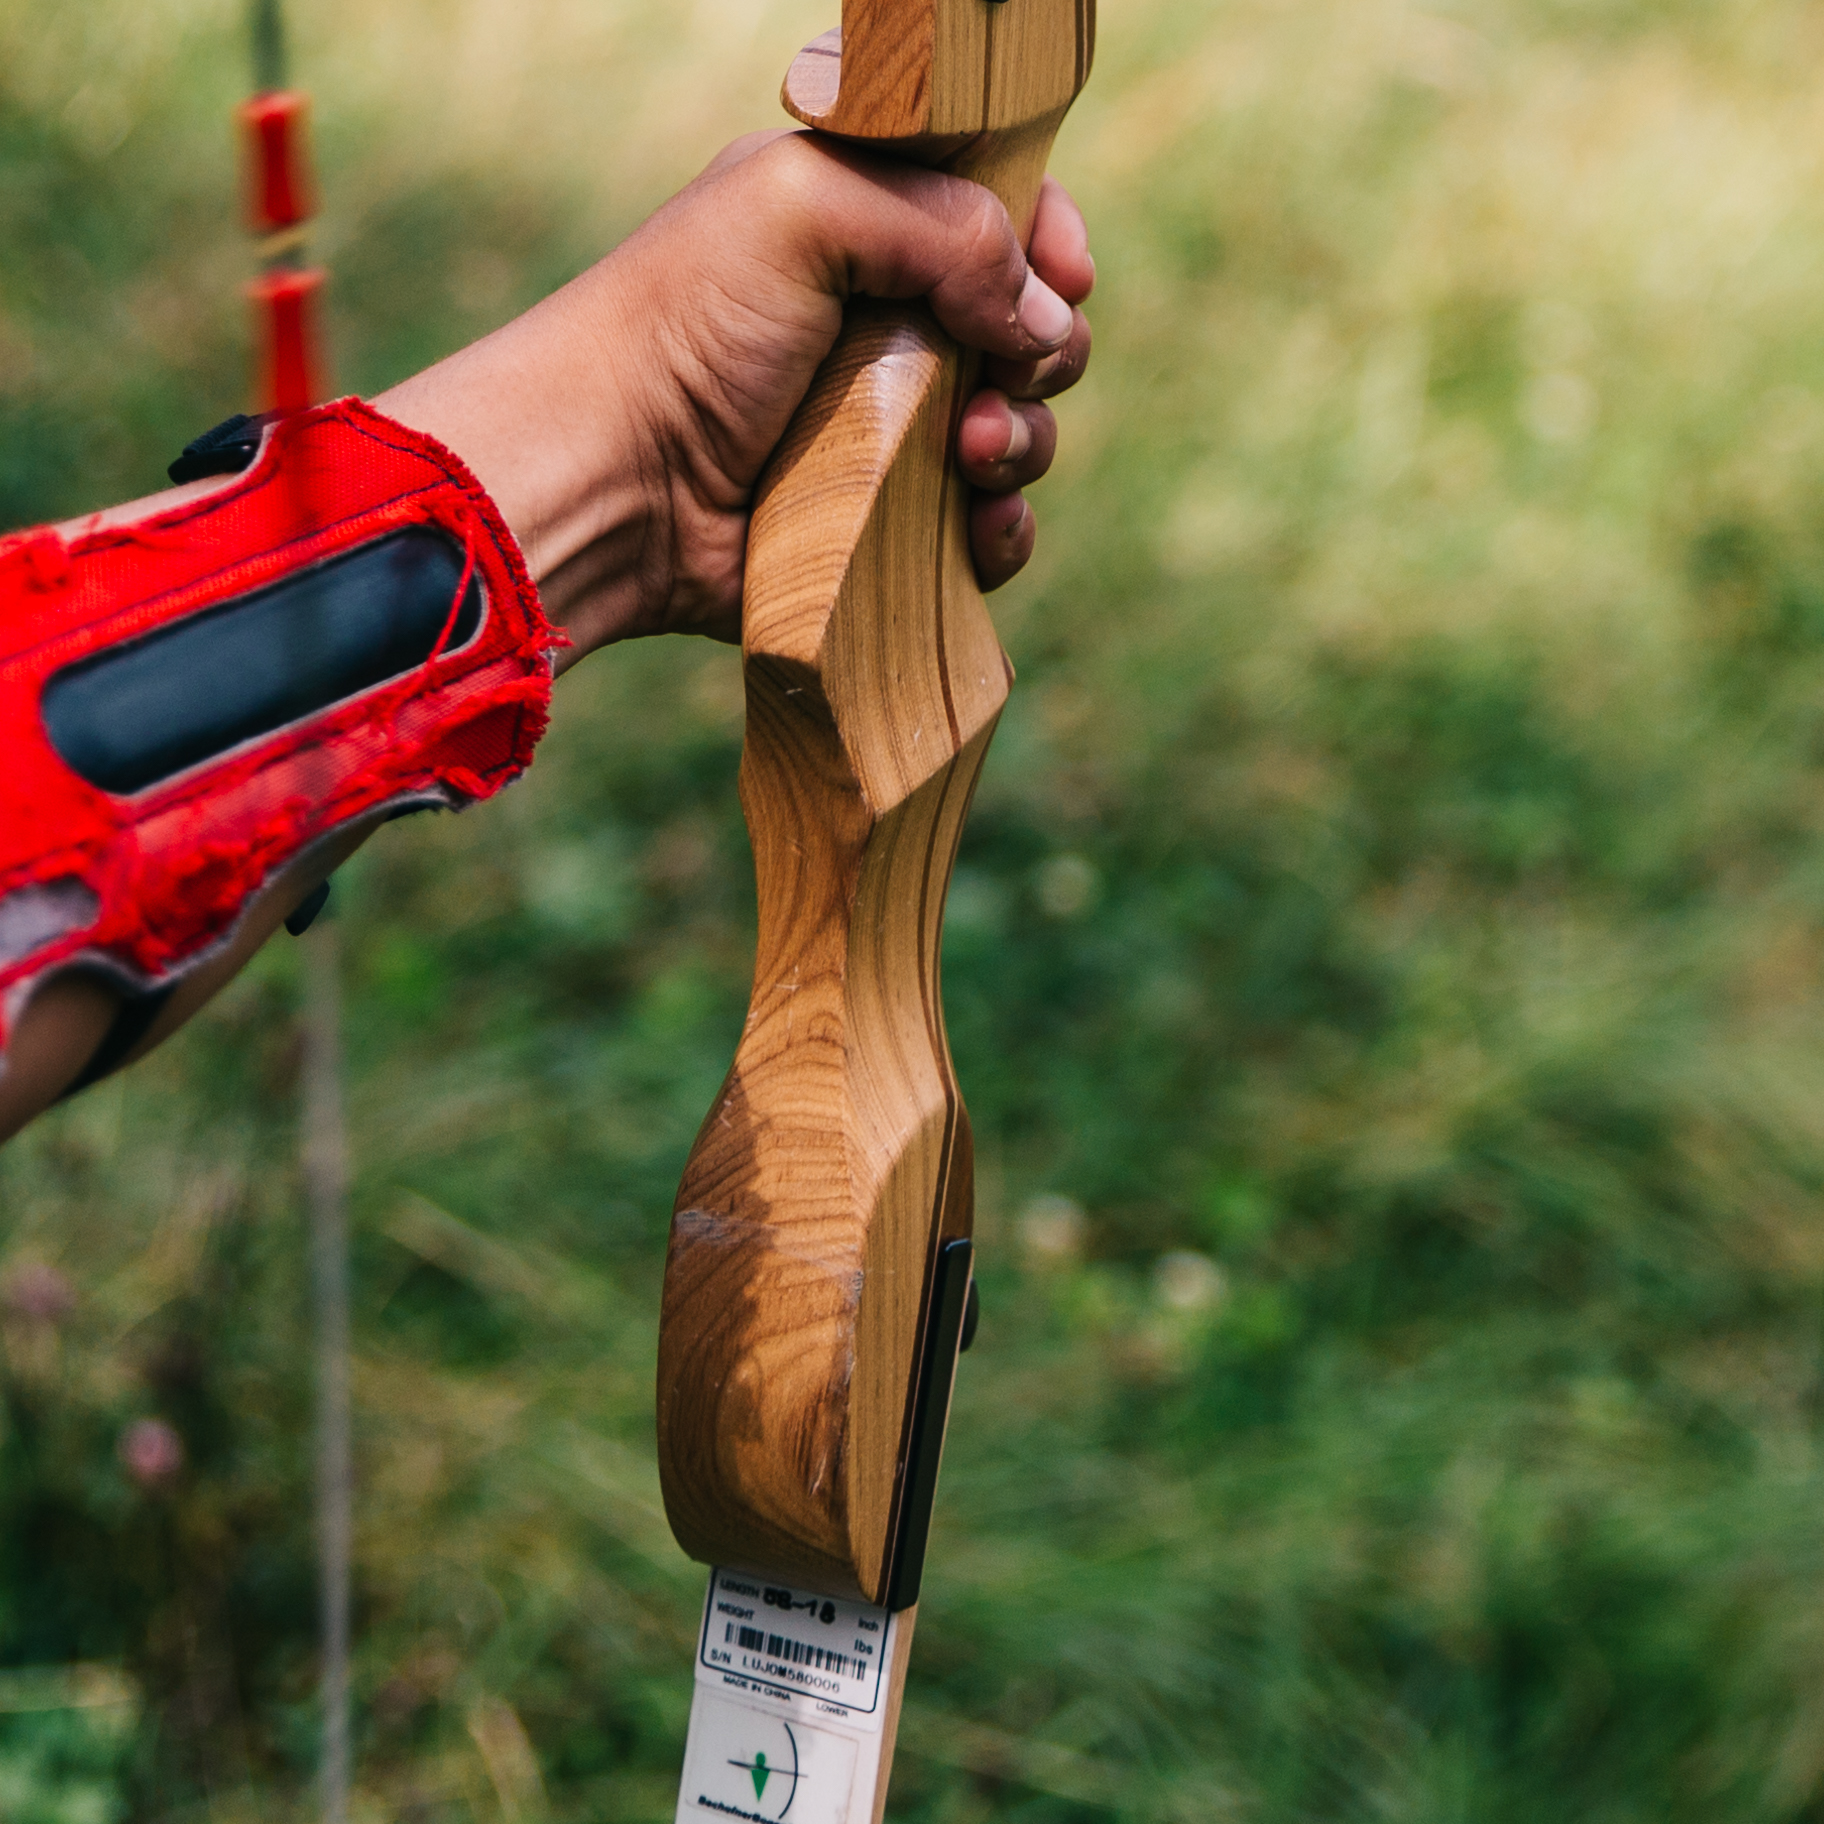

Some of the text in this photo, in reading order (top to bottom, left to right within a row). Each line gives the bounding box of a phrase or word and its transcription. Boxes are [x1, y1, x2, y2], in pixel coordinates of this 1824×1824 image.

[719, 1578, 760, 1598] LENGTH
[717, 1600, 873, 1655] WEIGHT lbs
[710, 1648, 731, 1664] S/N
[723, 1675, 792, 1701] MADE IN CHINA
[816, 1702, 849, 1718] LOWER
